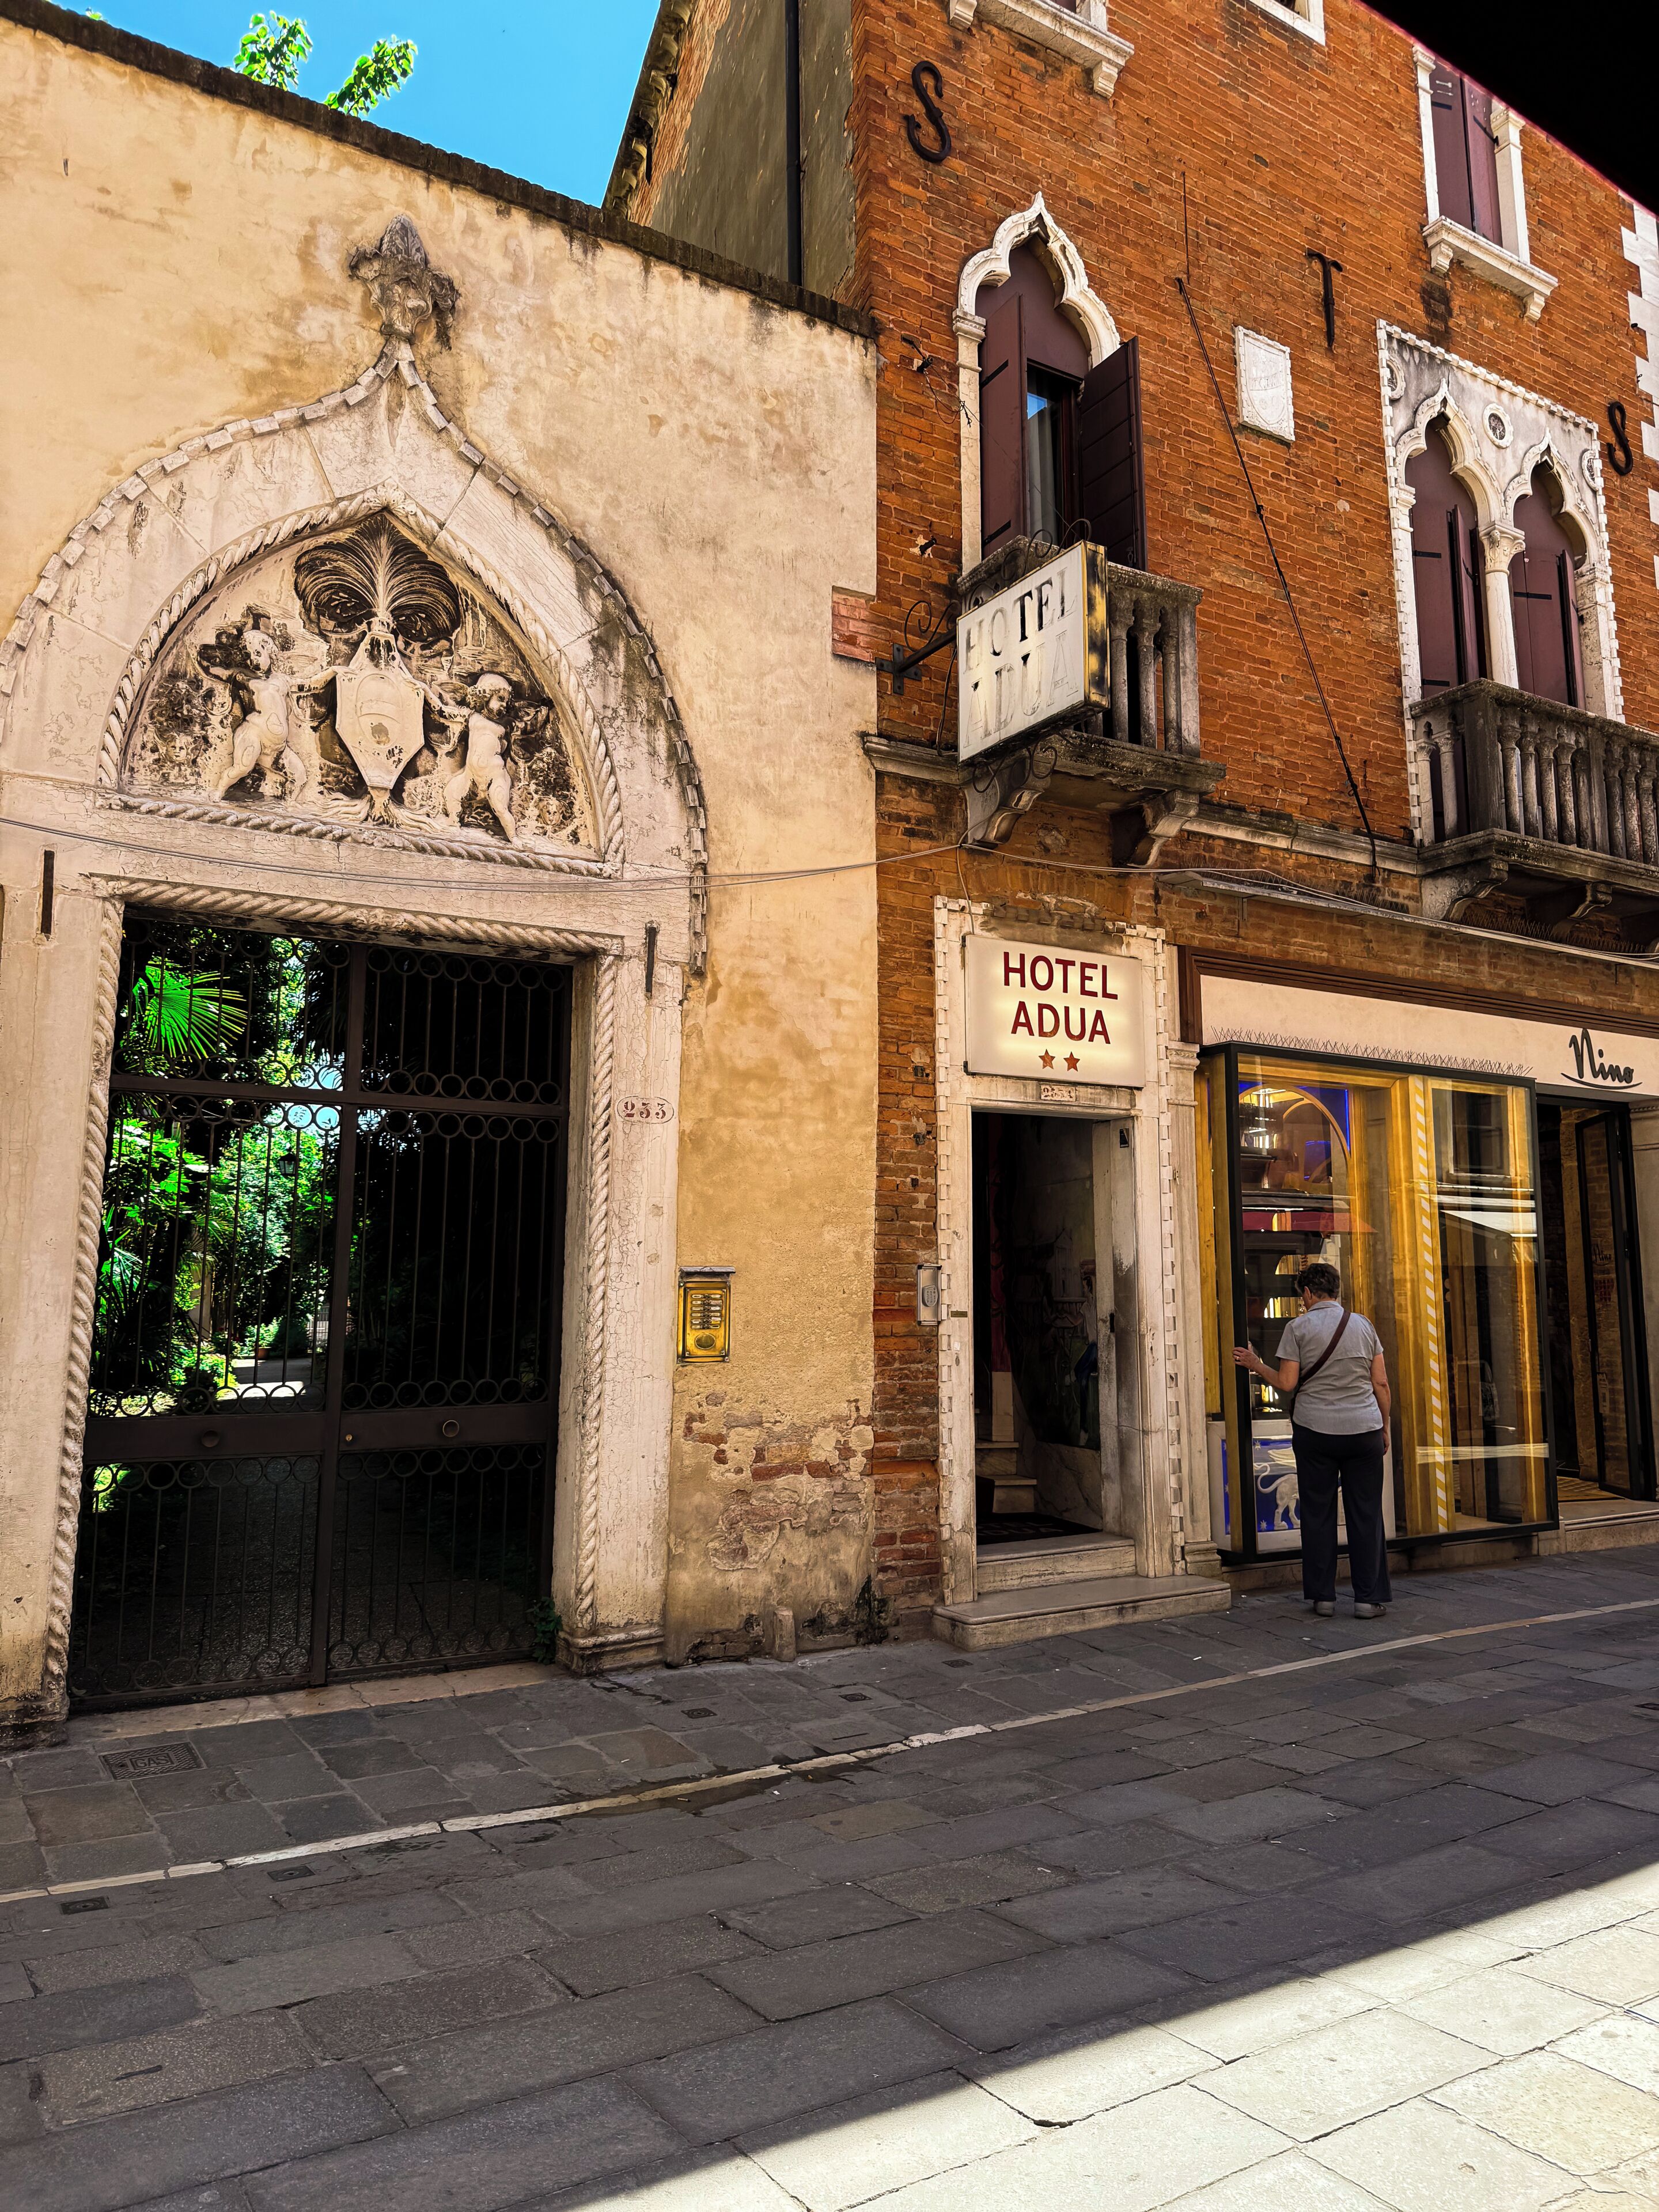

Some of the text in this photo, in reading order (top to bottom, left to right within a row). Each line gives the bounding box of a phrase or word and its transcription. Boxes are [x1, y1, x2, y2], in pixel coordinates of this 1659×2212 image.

[964, 567, 1078, 675] HOTEL
[963, 630, 1079, 749] ADUA
[1003, 951, 1118, 1000] HOTEL
[1010, 1001, 1111, 1044] ADUA
[1568, 1028, 1635, 1084] Nino
[134, 1755, 169, 1768] GAS
